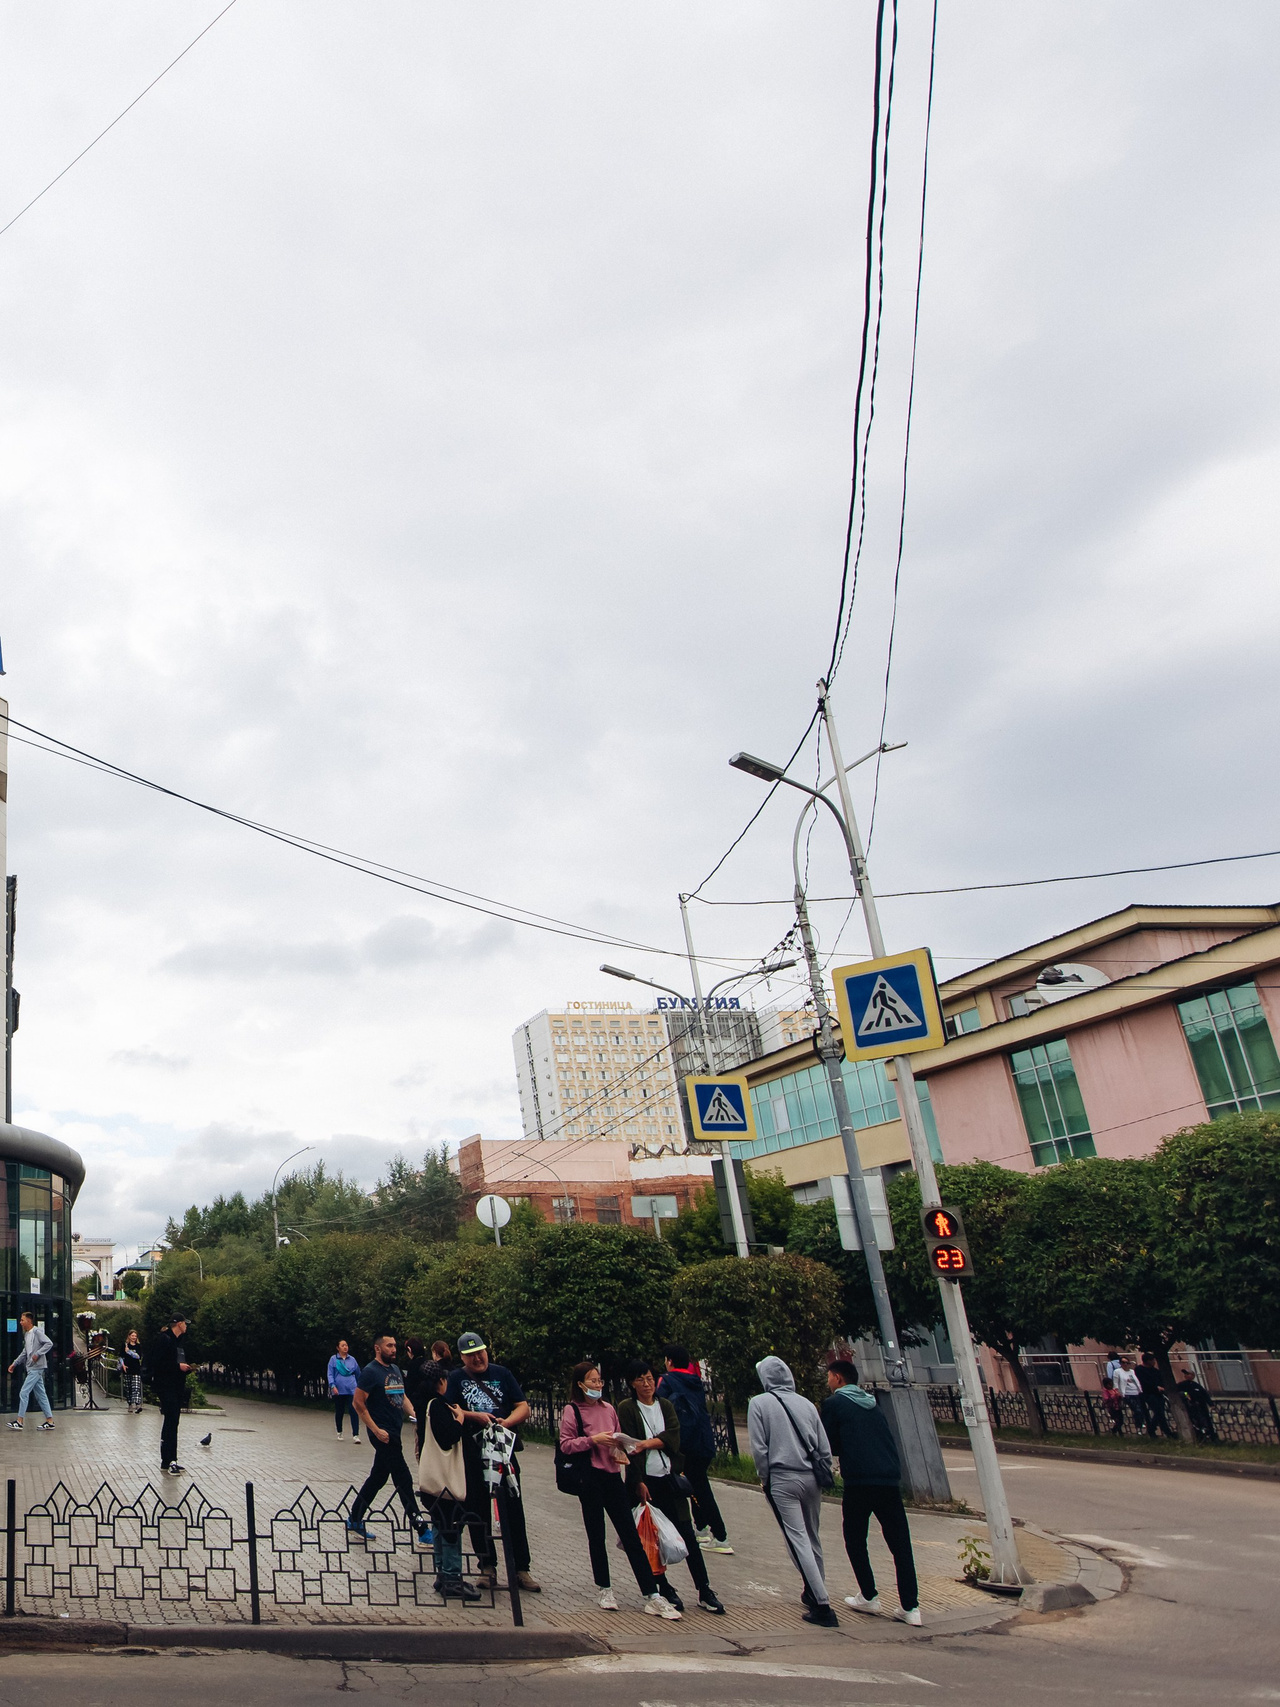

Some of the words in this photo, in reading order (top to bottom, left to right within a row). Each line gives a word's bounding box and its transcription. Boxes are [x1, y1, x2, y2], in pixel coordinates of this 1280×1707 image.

[566, 1001, 633, 1011] ГОСТИНИЦА
[656, 997, 741, 1010] БУРЯТИЯ
[936, 1249, 964, 1269] 23
